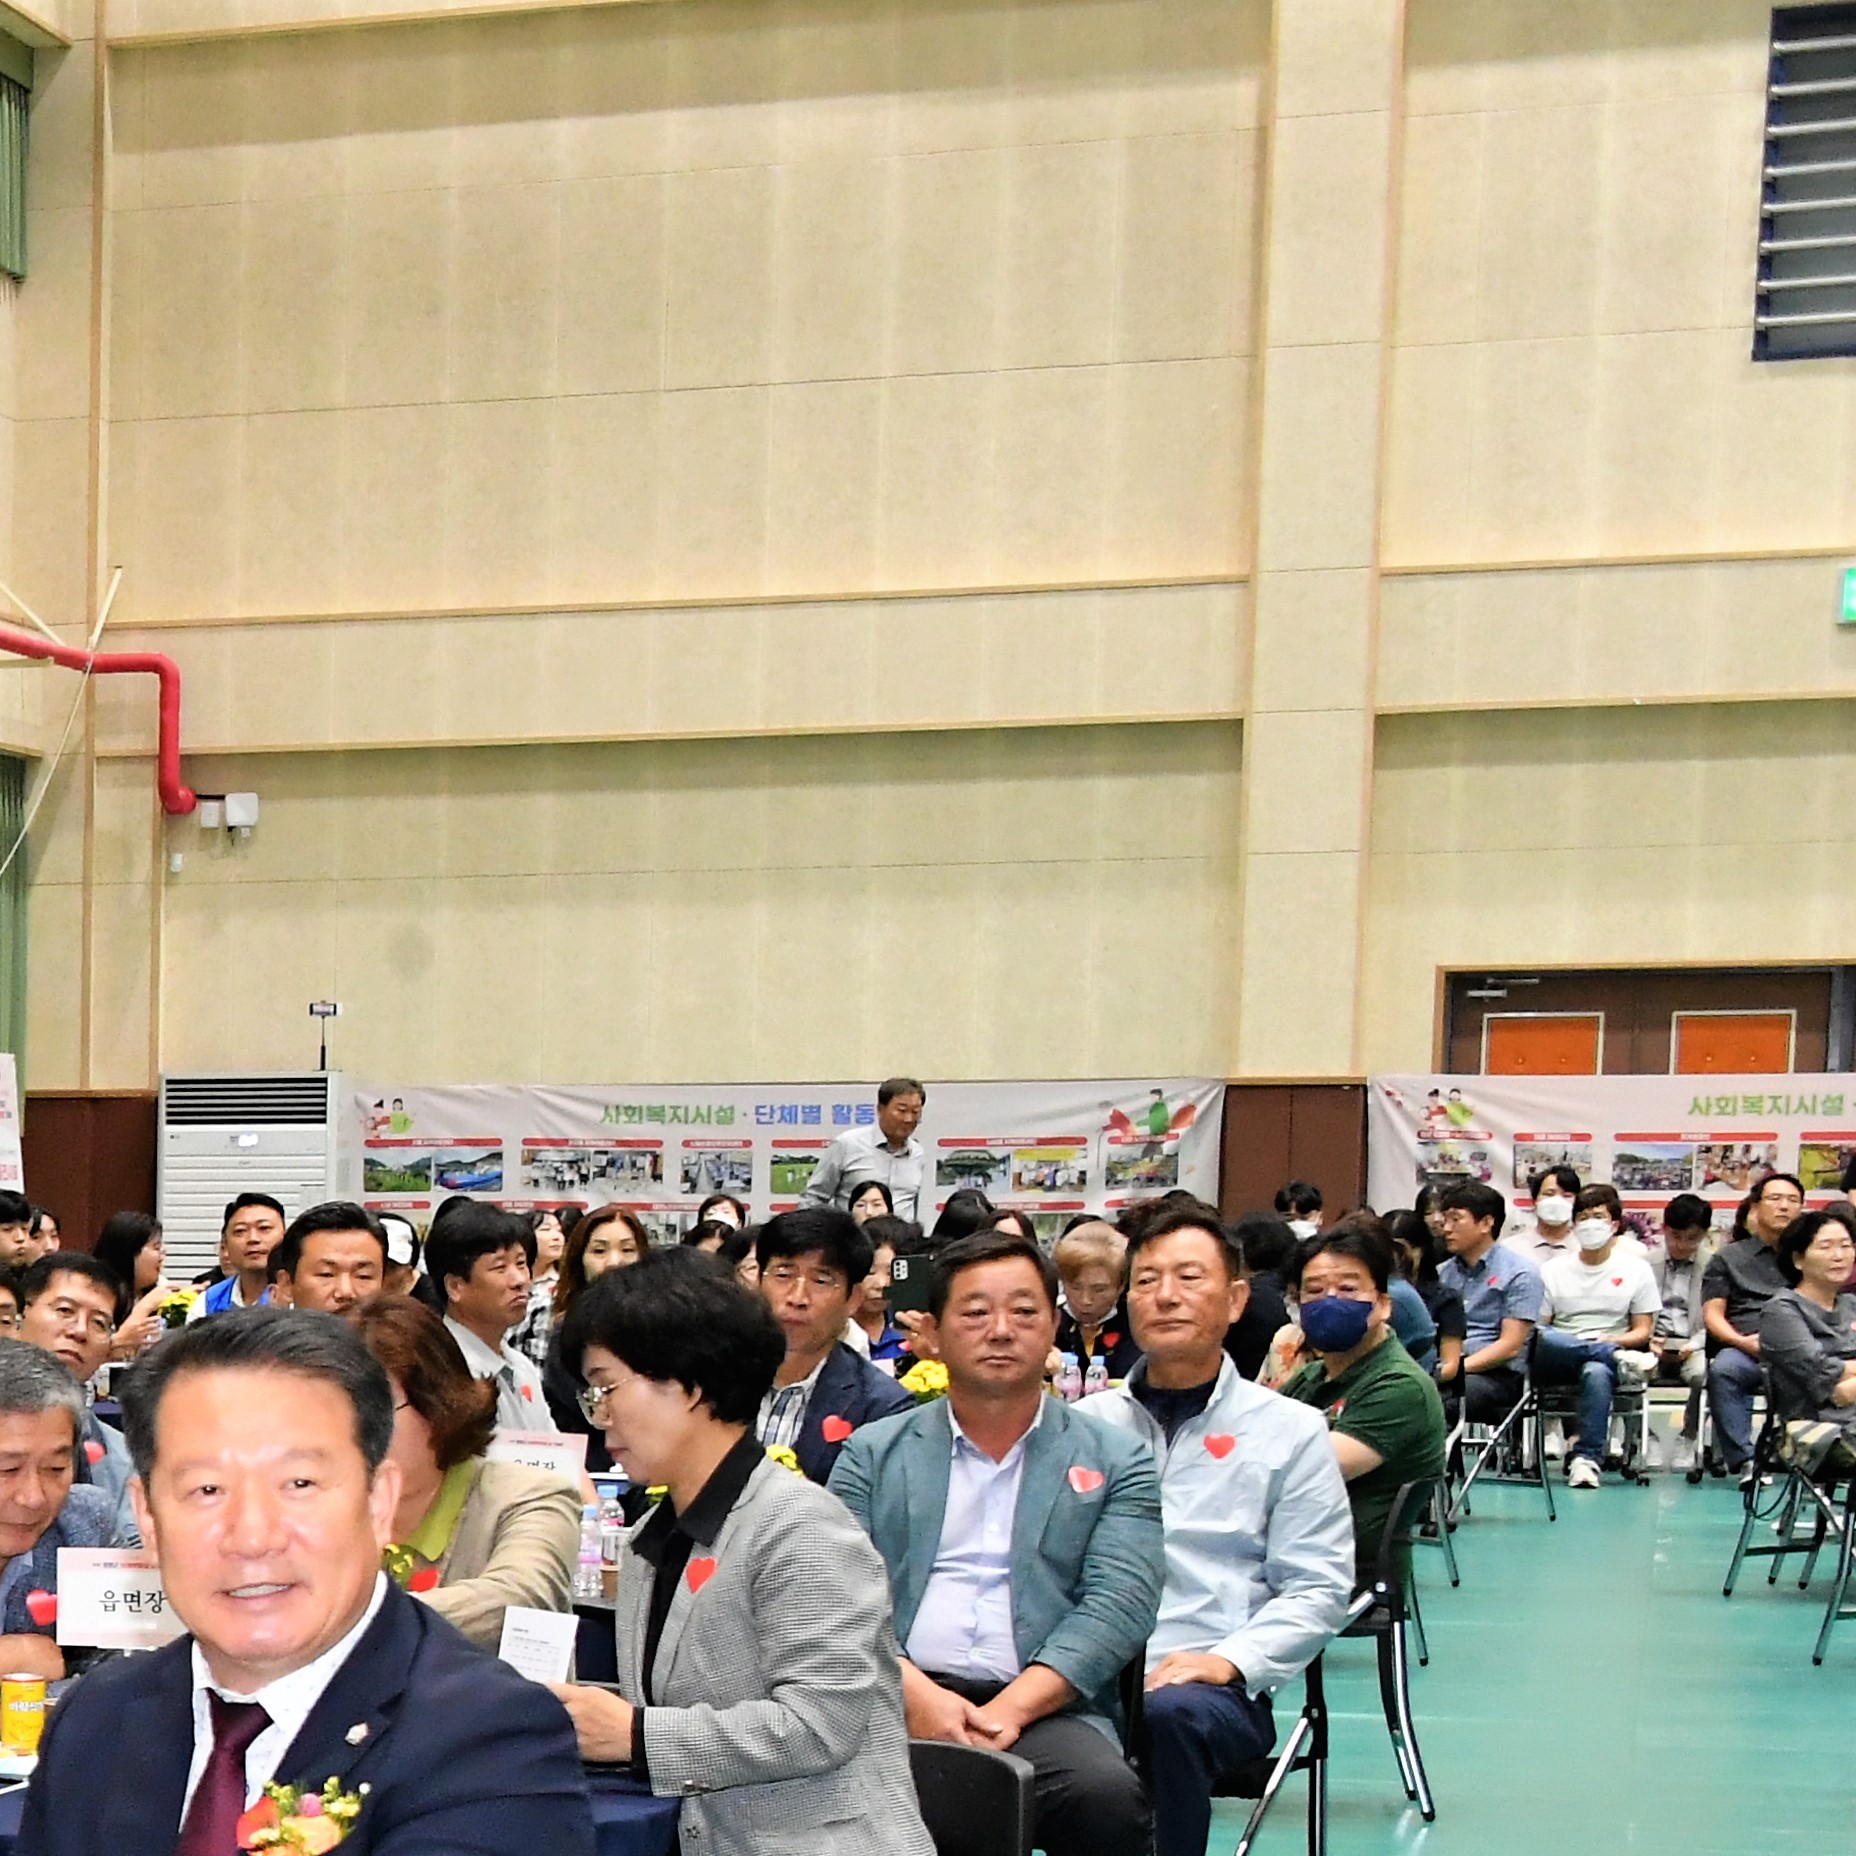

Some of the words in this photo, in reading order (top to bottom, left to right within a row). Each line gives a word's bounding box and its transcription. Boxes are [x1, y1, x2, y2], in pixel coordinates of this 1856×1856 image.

[600, 1104, 735, 1125] 사회복지시설
[755, 1104, 822, 1125] 단체별
[1688, 1094, 1844, 1116] 사회복지시설
[99, 1590, 168, 1614] 읍면장
